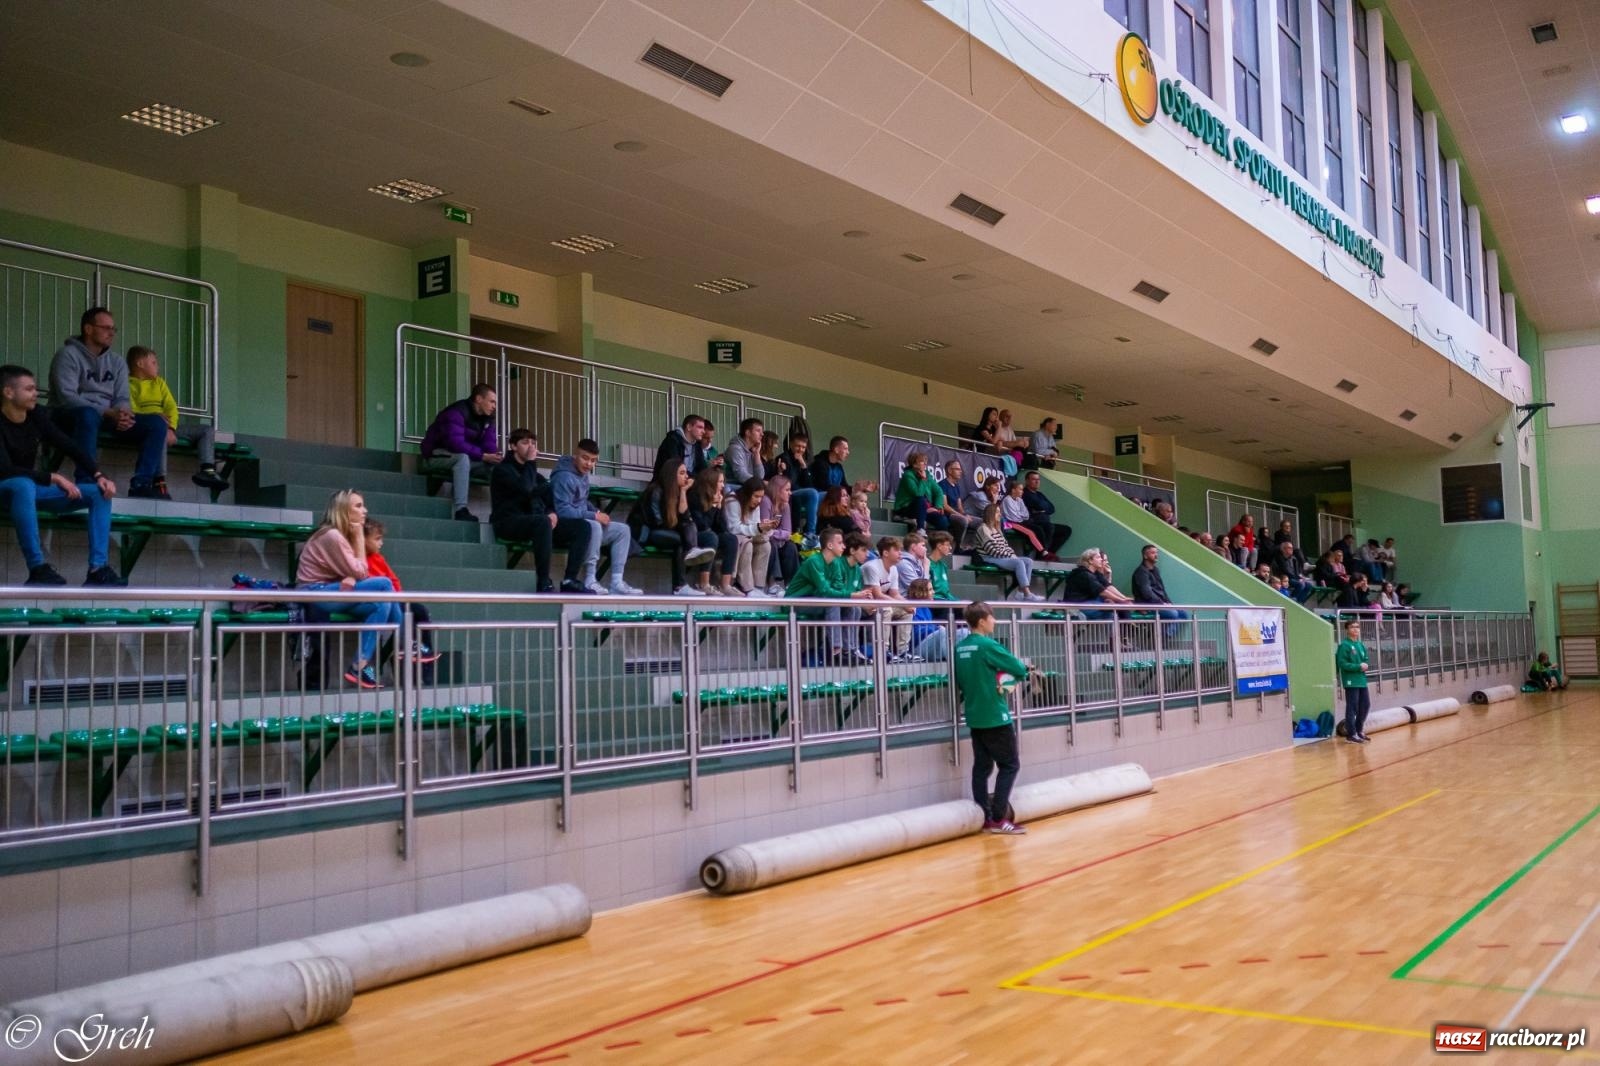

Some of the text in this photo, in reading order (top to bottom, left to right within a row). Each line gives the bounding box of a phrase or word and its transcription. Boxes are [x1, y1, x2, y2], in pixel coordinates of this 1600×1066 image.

[1159, 77, 1232, 162] OŚRODEK
[1233, 136, 1283, 200] SPORTU
[1282, 175, 1290, 206] I
[1290, 181, 1344, 247] REKREACJI
[426, 270, 444, 294] E
[717, 348, 733, 362] E
[1121, 441, 1133, 453] F
